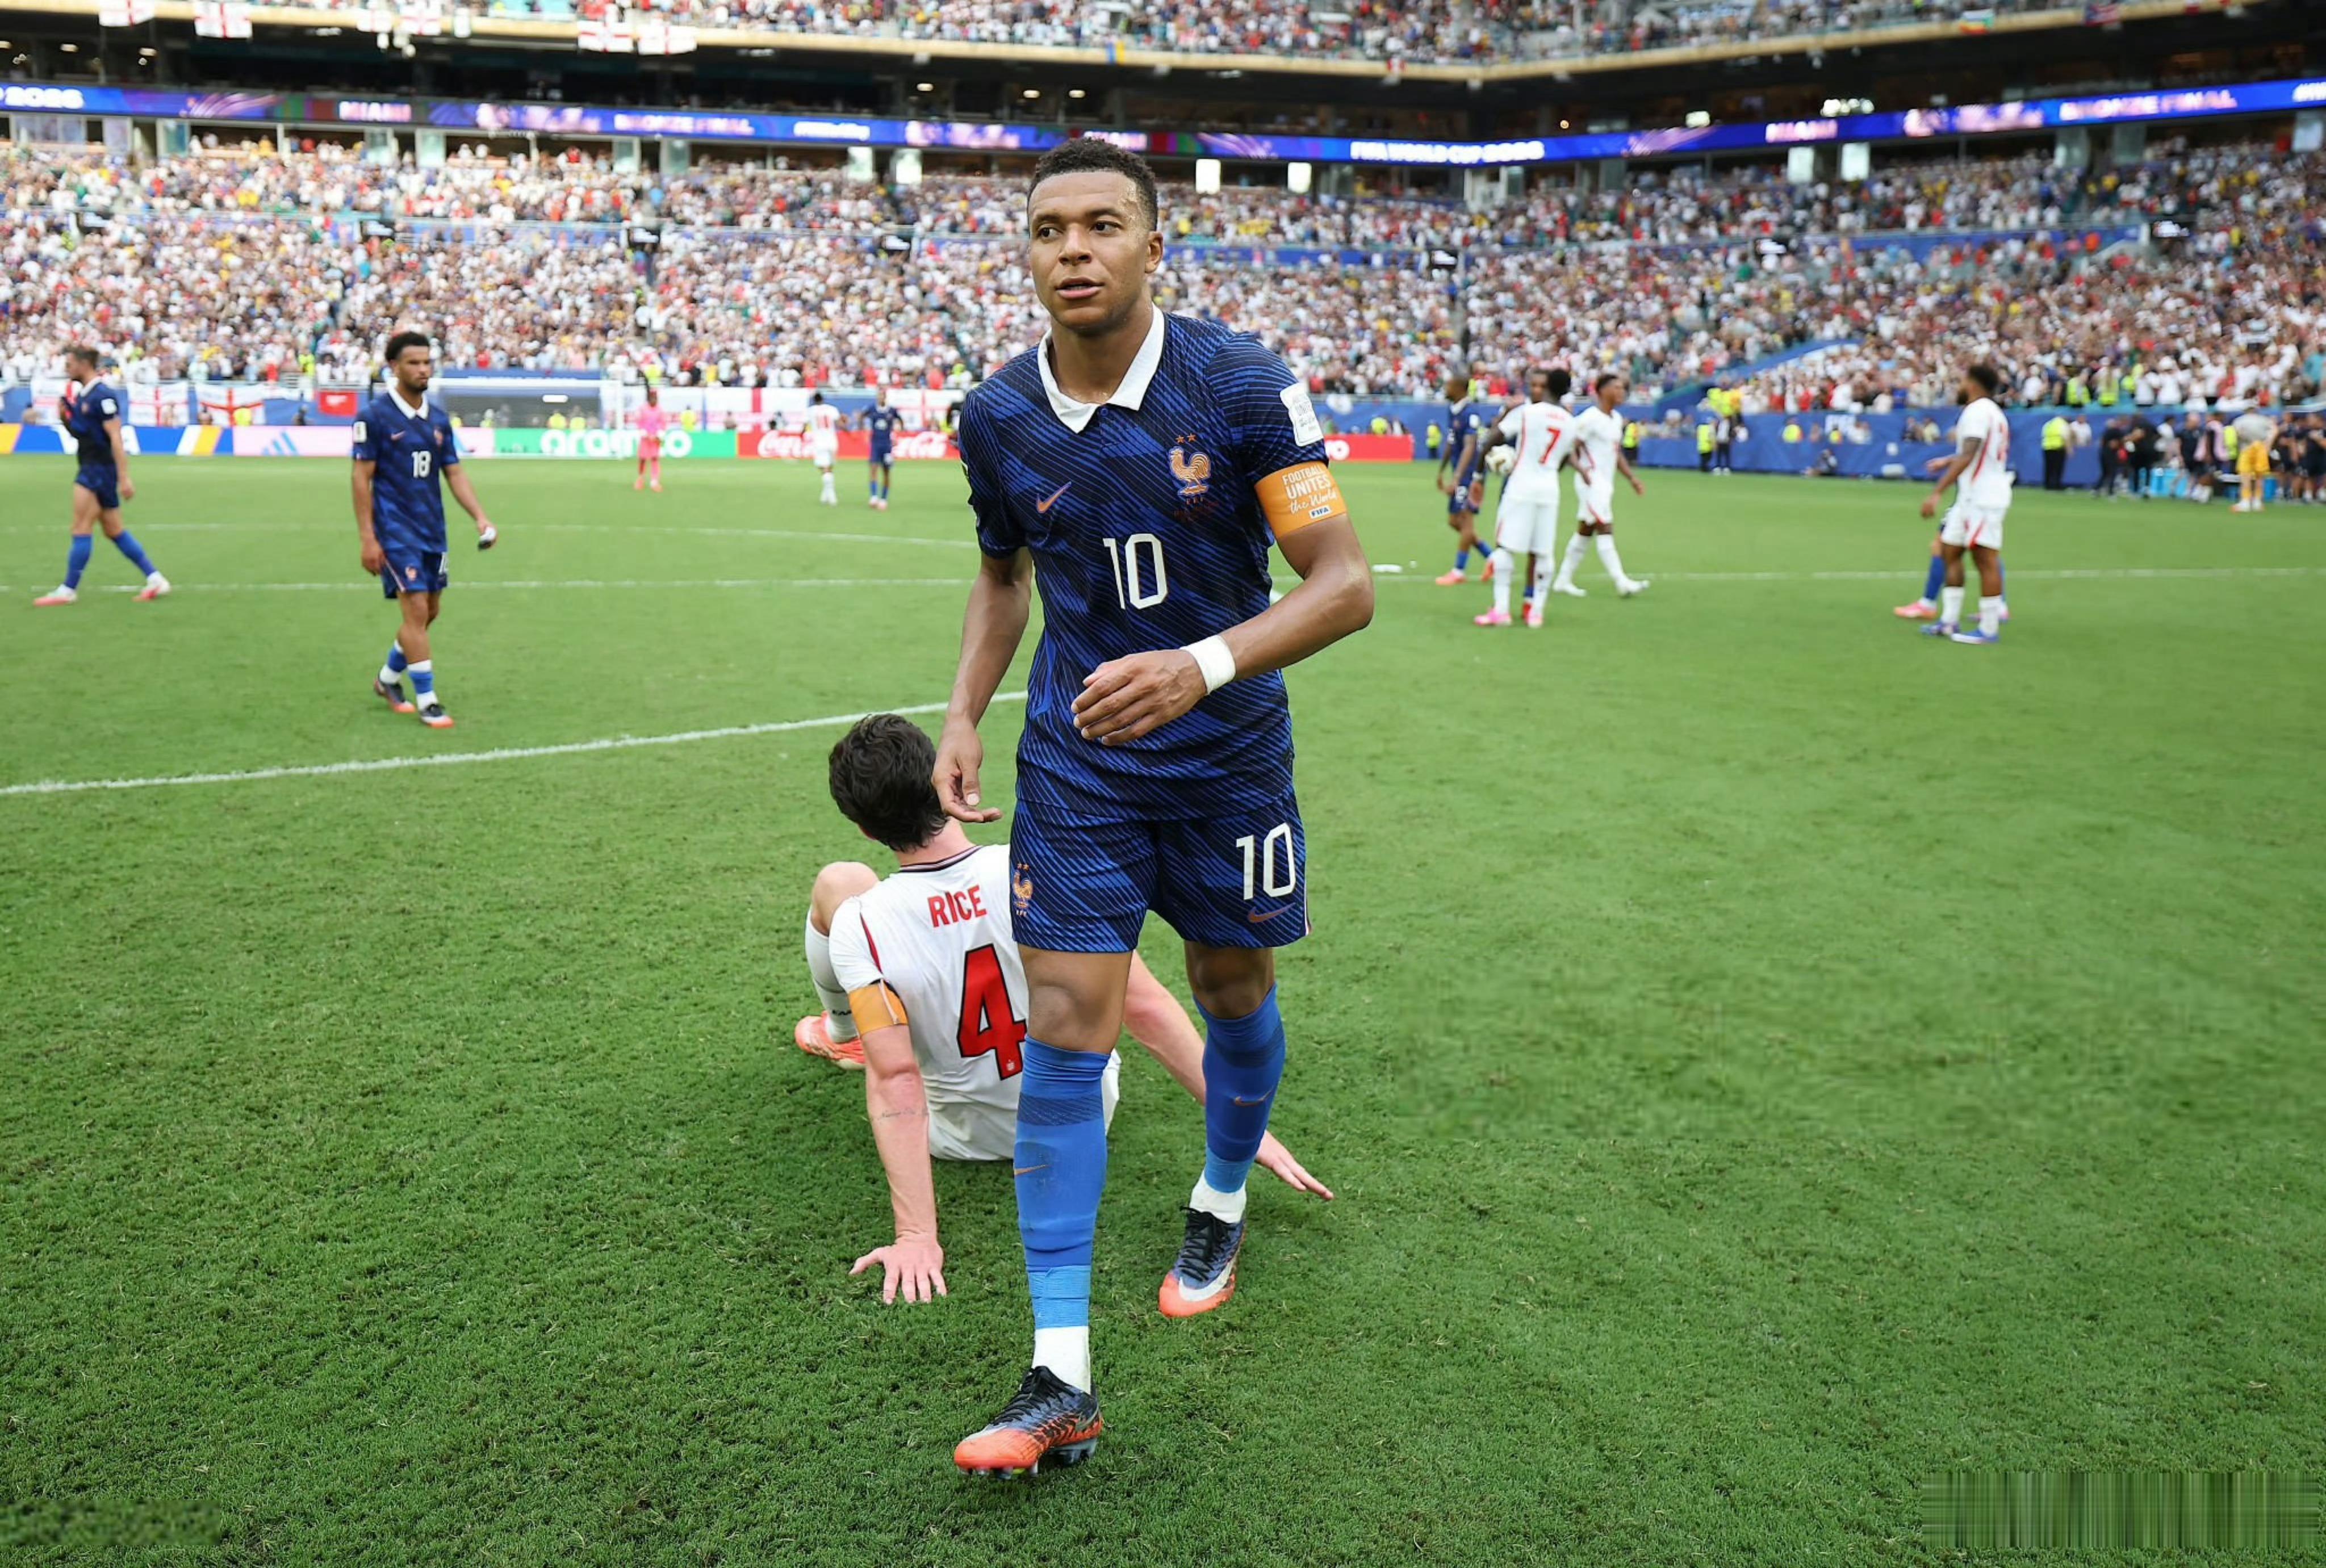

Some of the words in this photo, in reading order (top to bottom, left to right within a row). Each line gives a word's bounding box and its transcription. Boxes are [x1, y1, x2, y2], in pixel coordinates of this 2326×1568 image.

[1538, 426, 1561, 464] 7
[411, 450, 431, 478] 18
[1282, 464, 1325, 486] FOOTBALL
[1286, 473, 1331, 500] UNITES
[1290, 499, 1309, 515] the
[1311, 507, 1329, 517] FIFA
[1102, 533, 1168, 610] 10
[1236, 822, 1296, 900] 10
[927, 884, 987, 928] RICE
[956, 943, 1027, 1080] 4
